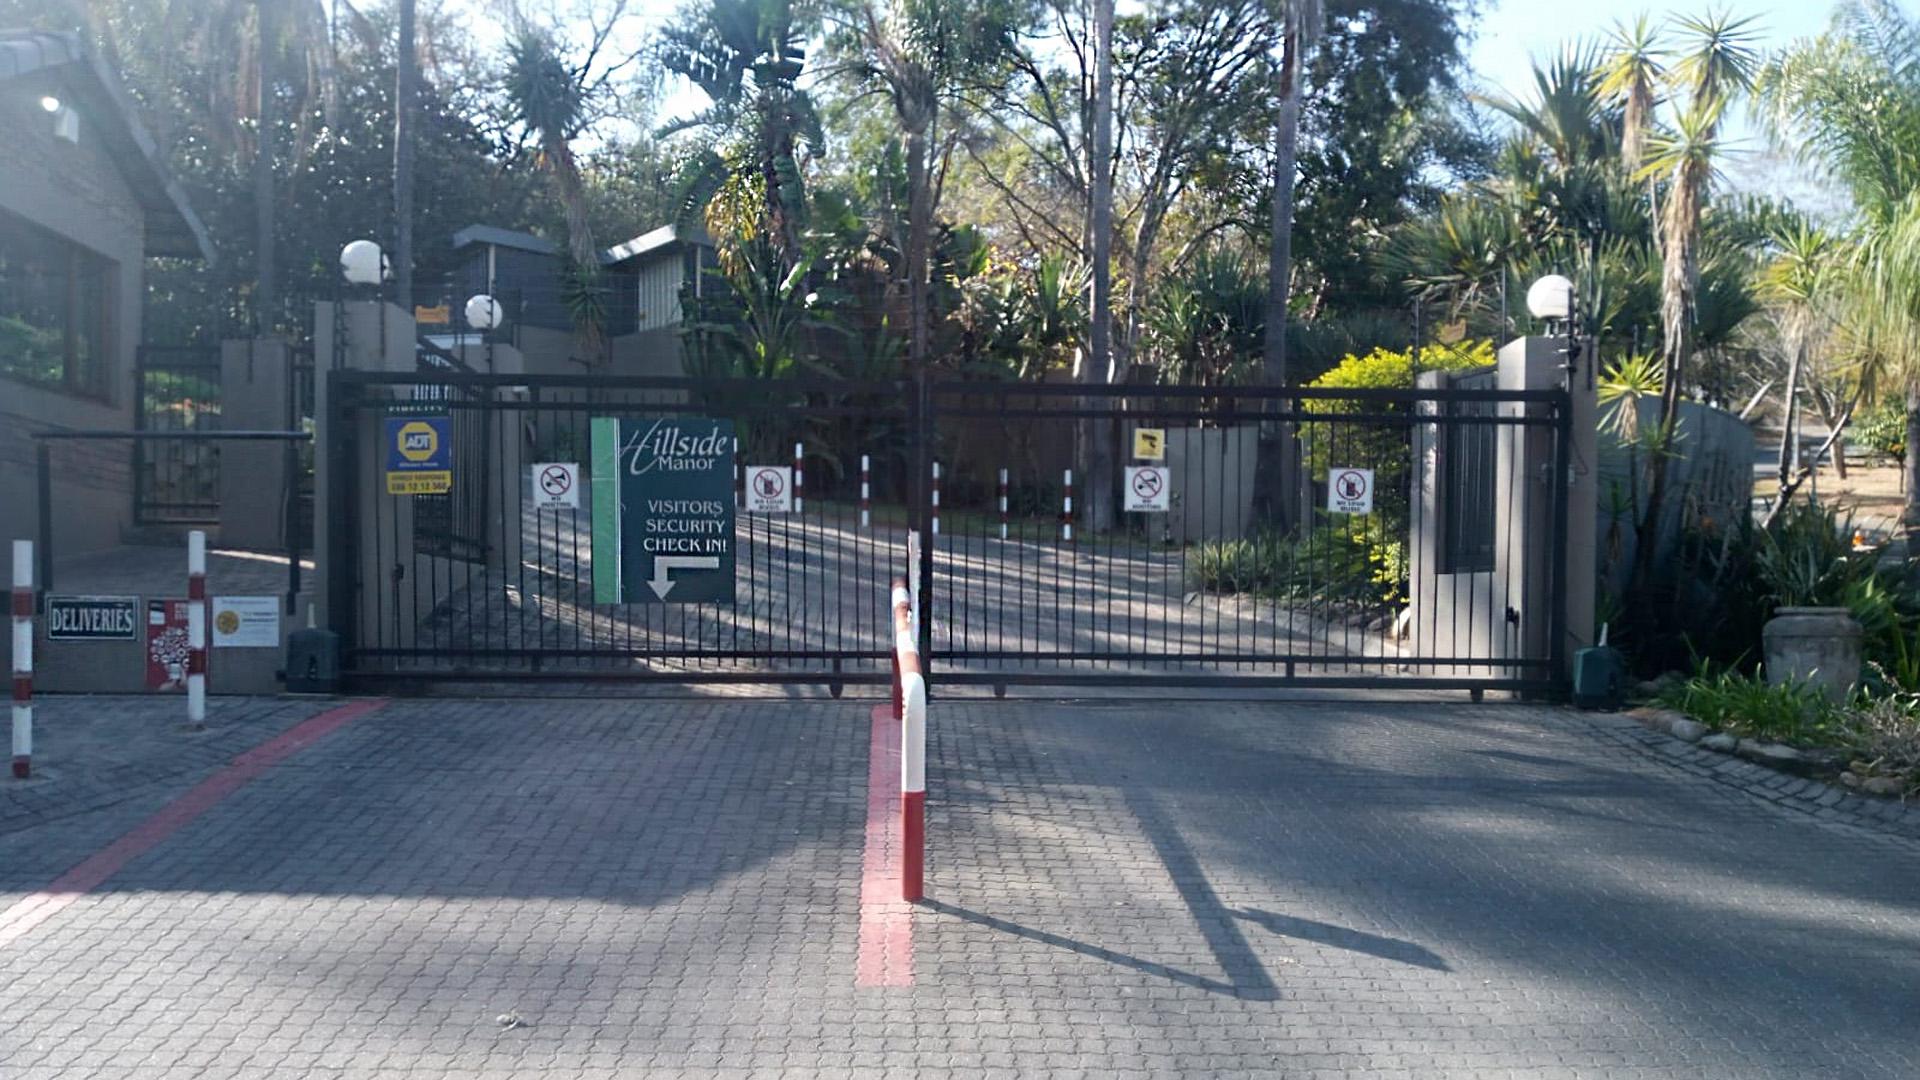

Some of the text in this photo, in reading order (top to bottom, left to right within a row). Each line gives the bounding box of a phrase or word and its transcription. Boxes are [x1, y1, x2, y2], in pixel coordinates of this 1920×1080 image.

[406, 435, 430, 448] ADT
[620, 418, 728, 475] Hillside
[659, 456, 716, 470] Manor
[647, 499, 724, 515] VISITORS
[645, 519, 725, 533] SECURITY
[643, 538, 726, 552] CHECK IN!
[52, 608, 132, 632] DELIVERIES
